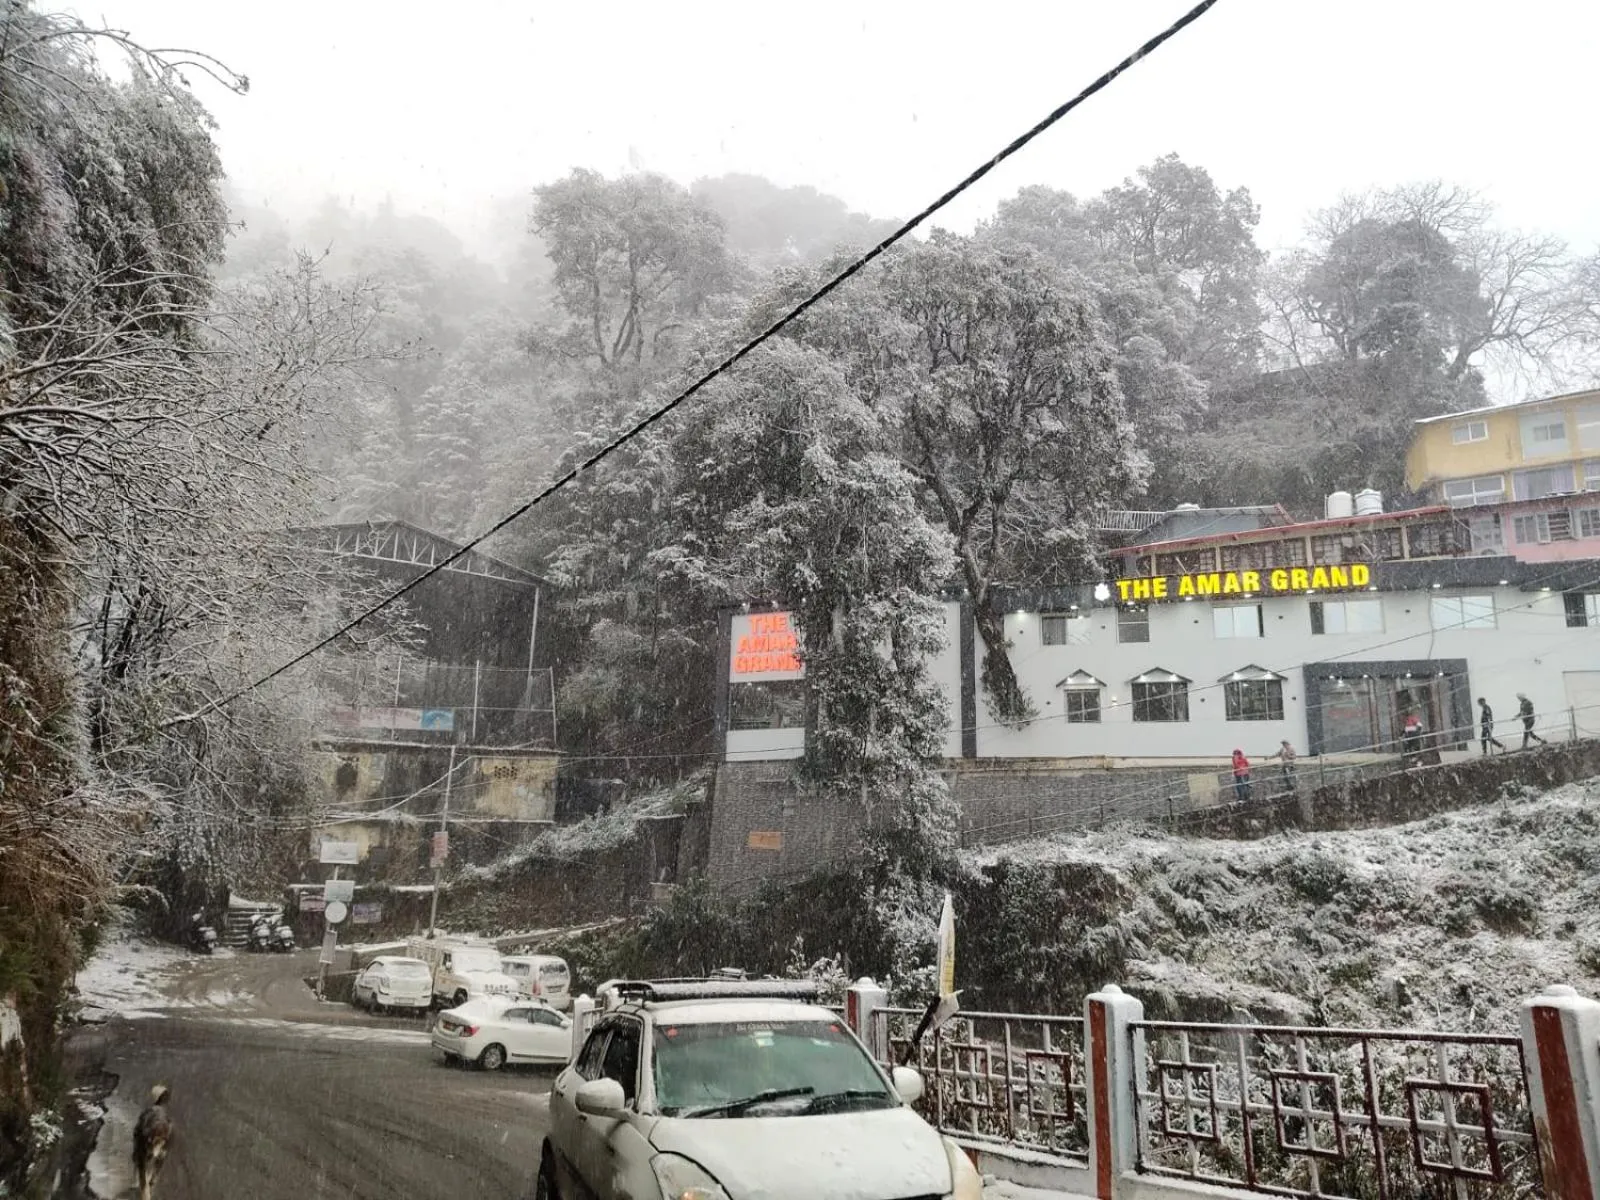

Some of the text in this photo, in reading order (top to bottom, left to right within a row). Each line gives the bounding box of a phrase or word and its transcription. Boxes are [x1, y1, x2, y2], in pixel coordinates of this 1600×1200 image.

[1116, 564, 1370, 600] THE AMAR GRAND
[749, 614, 787, 634] THE
[736, 634, 797, 654] AMAR
